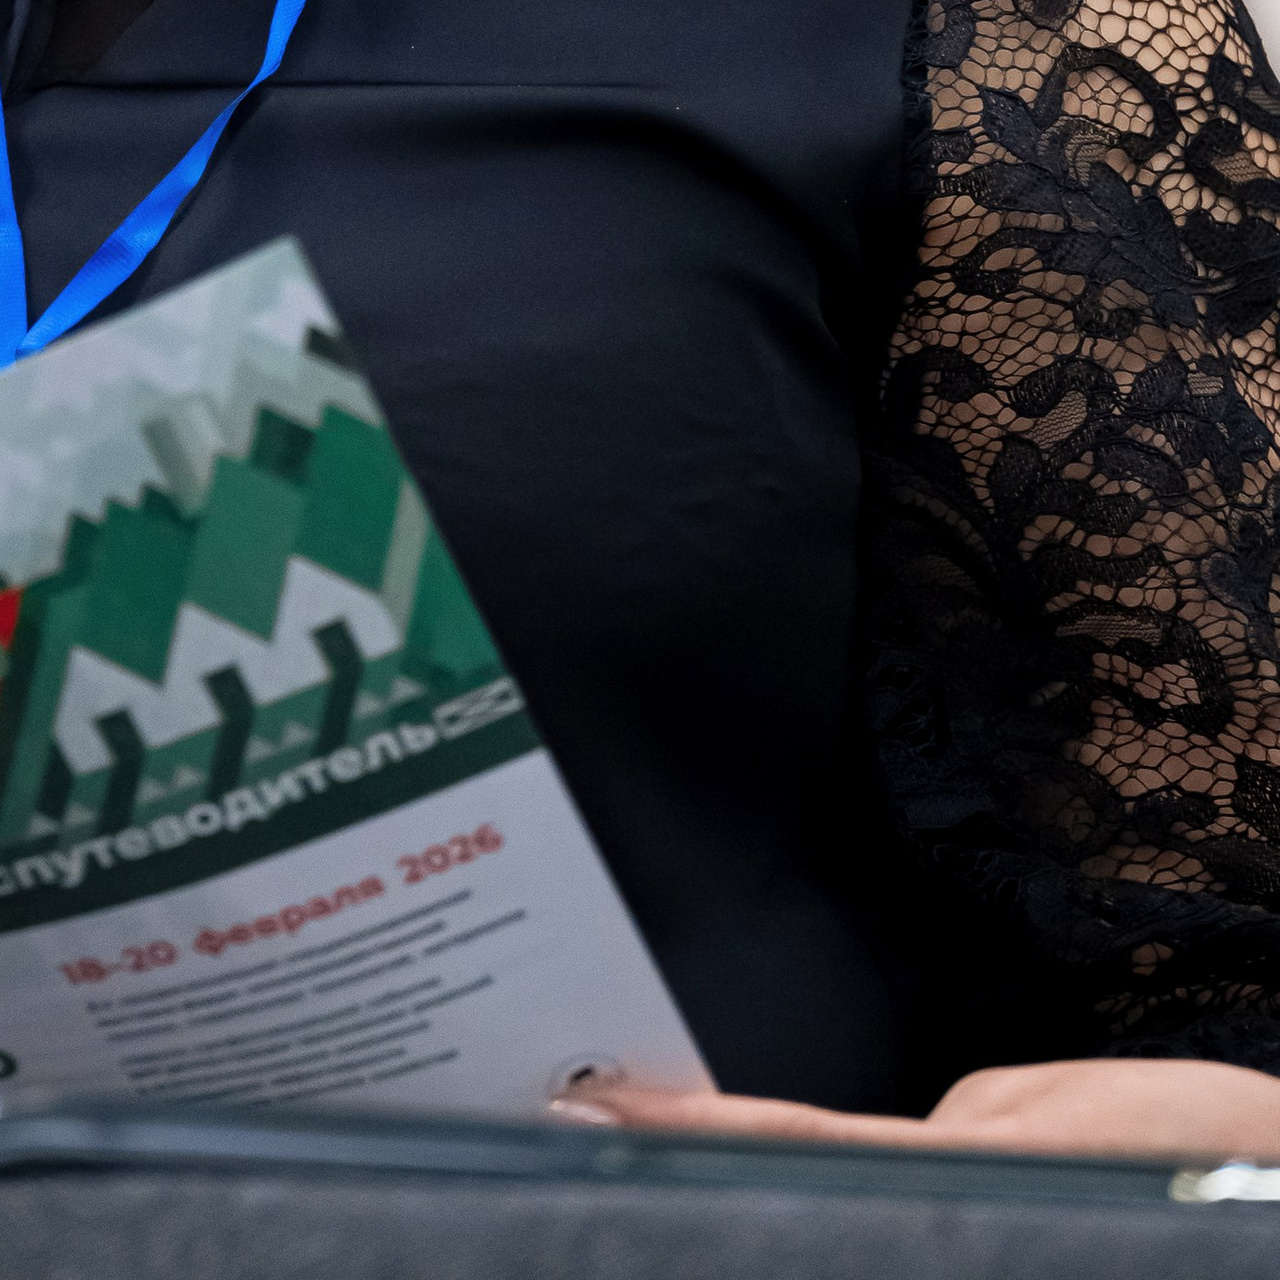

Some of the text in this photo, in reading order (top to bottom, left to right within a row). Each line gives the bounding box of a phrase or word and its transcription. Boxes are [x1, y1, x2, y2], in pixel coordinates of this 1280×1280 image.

[20, 719, 437, 888] путеводитель
[193, 876, 385, 956] февраля
[396, 823, 506, 885] 2026
